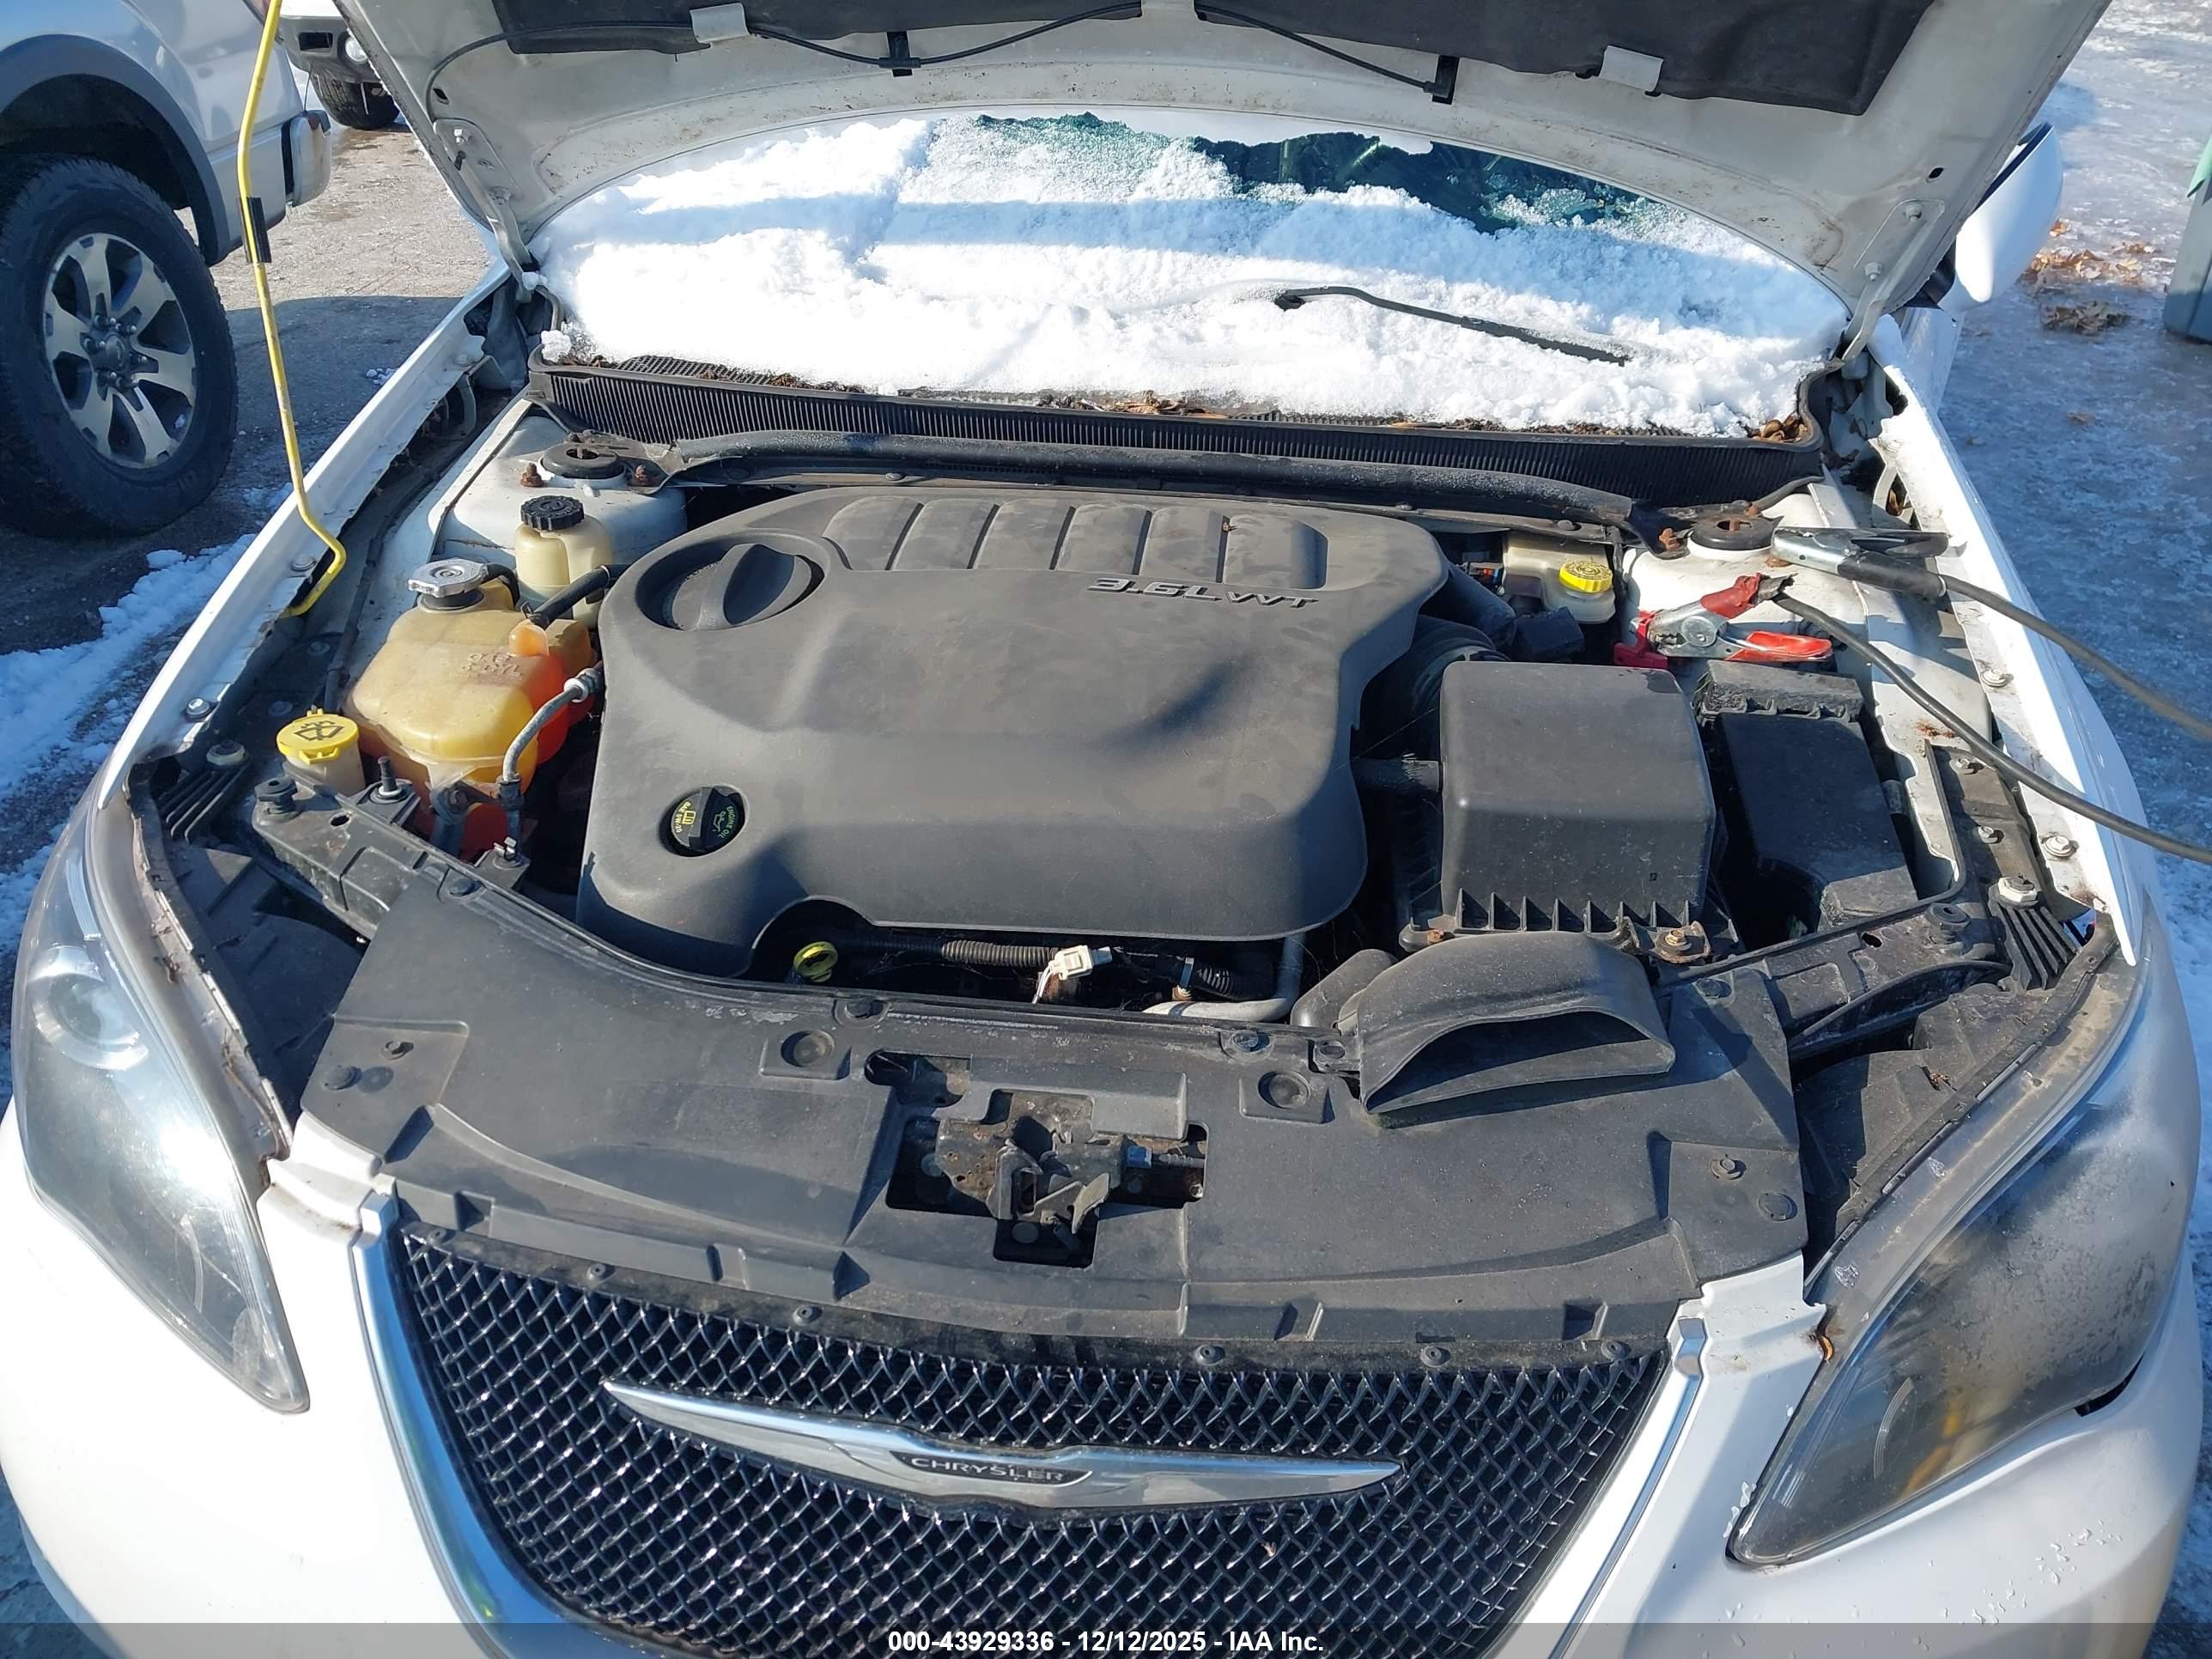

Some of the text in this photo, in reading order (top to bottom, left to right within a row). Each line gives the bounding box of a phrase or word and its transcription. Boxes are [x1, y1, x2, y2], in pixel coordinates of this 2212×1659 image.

[1087, 578, 1320, 609] 3.6L VVT
[911, 1458, 1064, 1481] CHRYSLER
